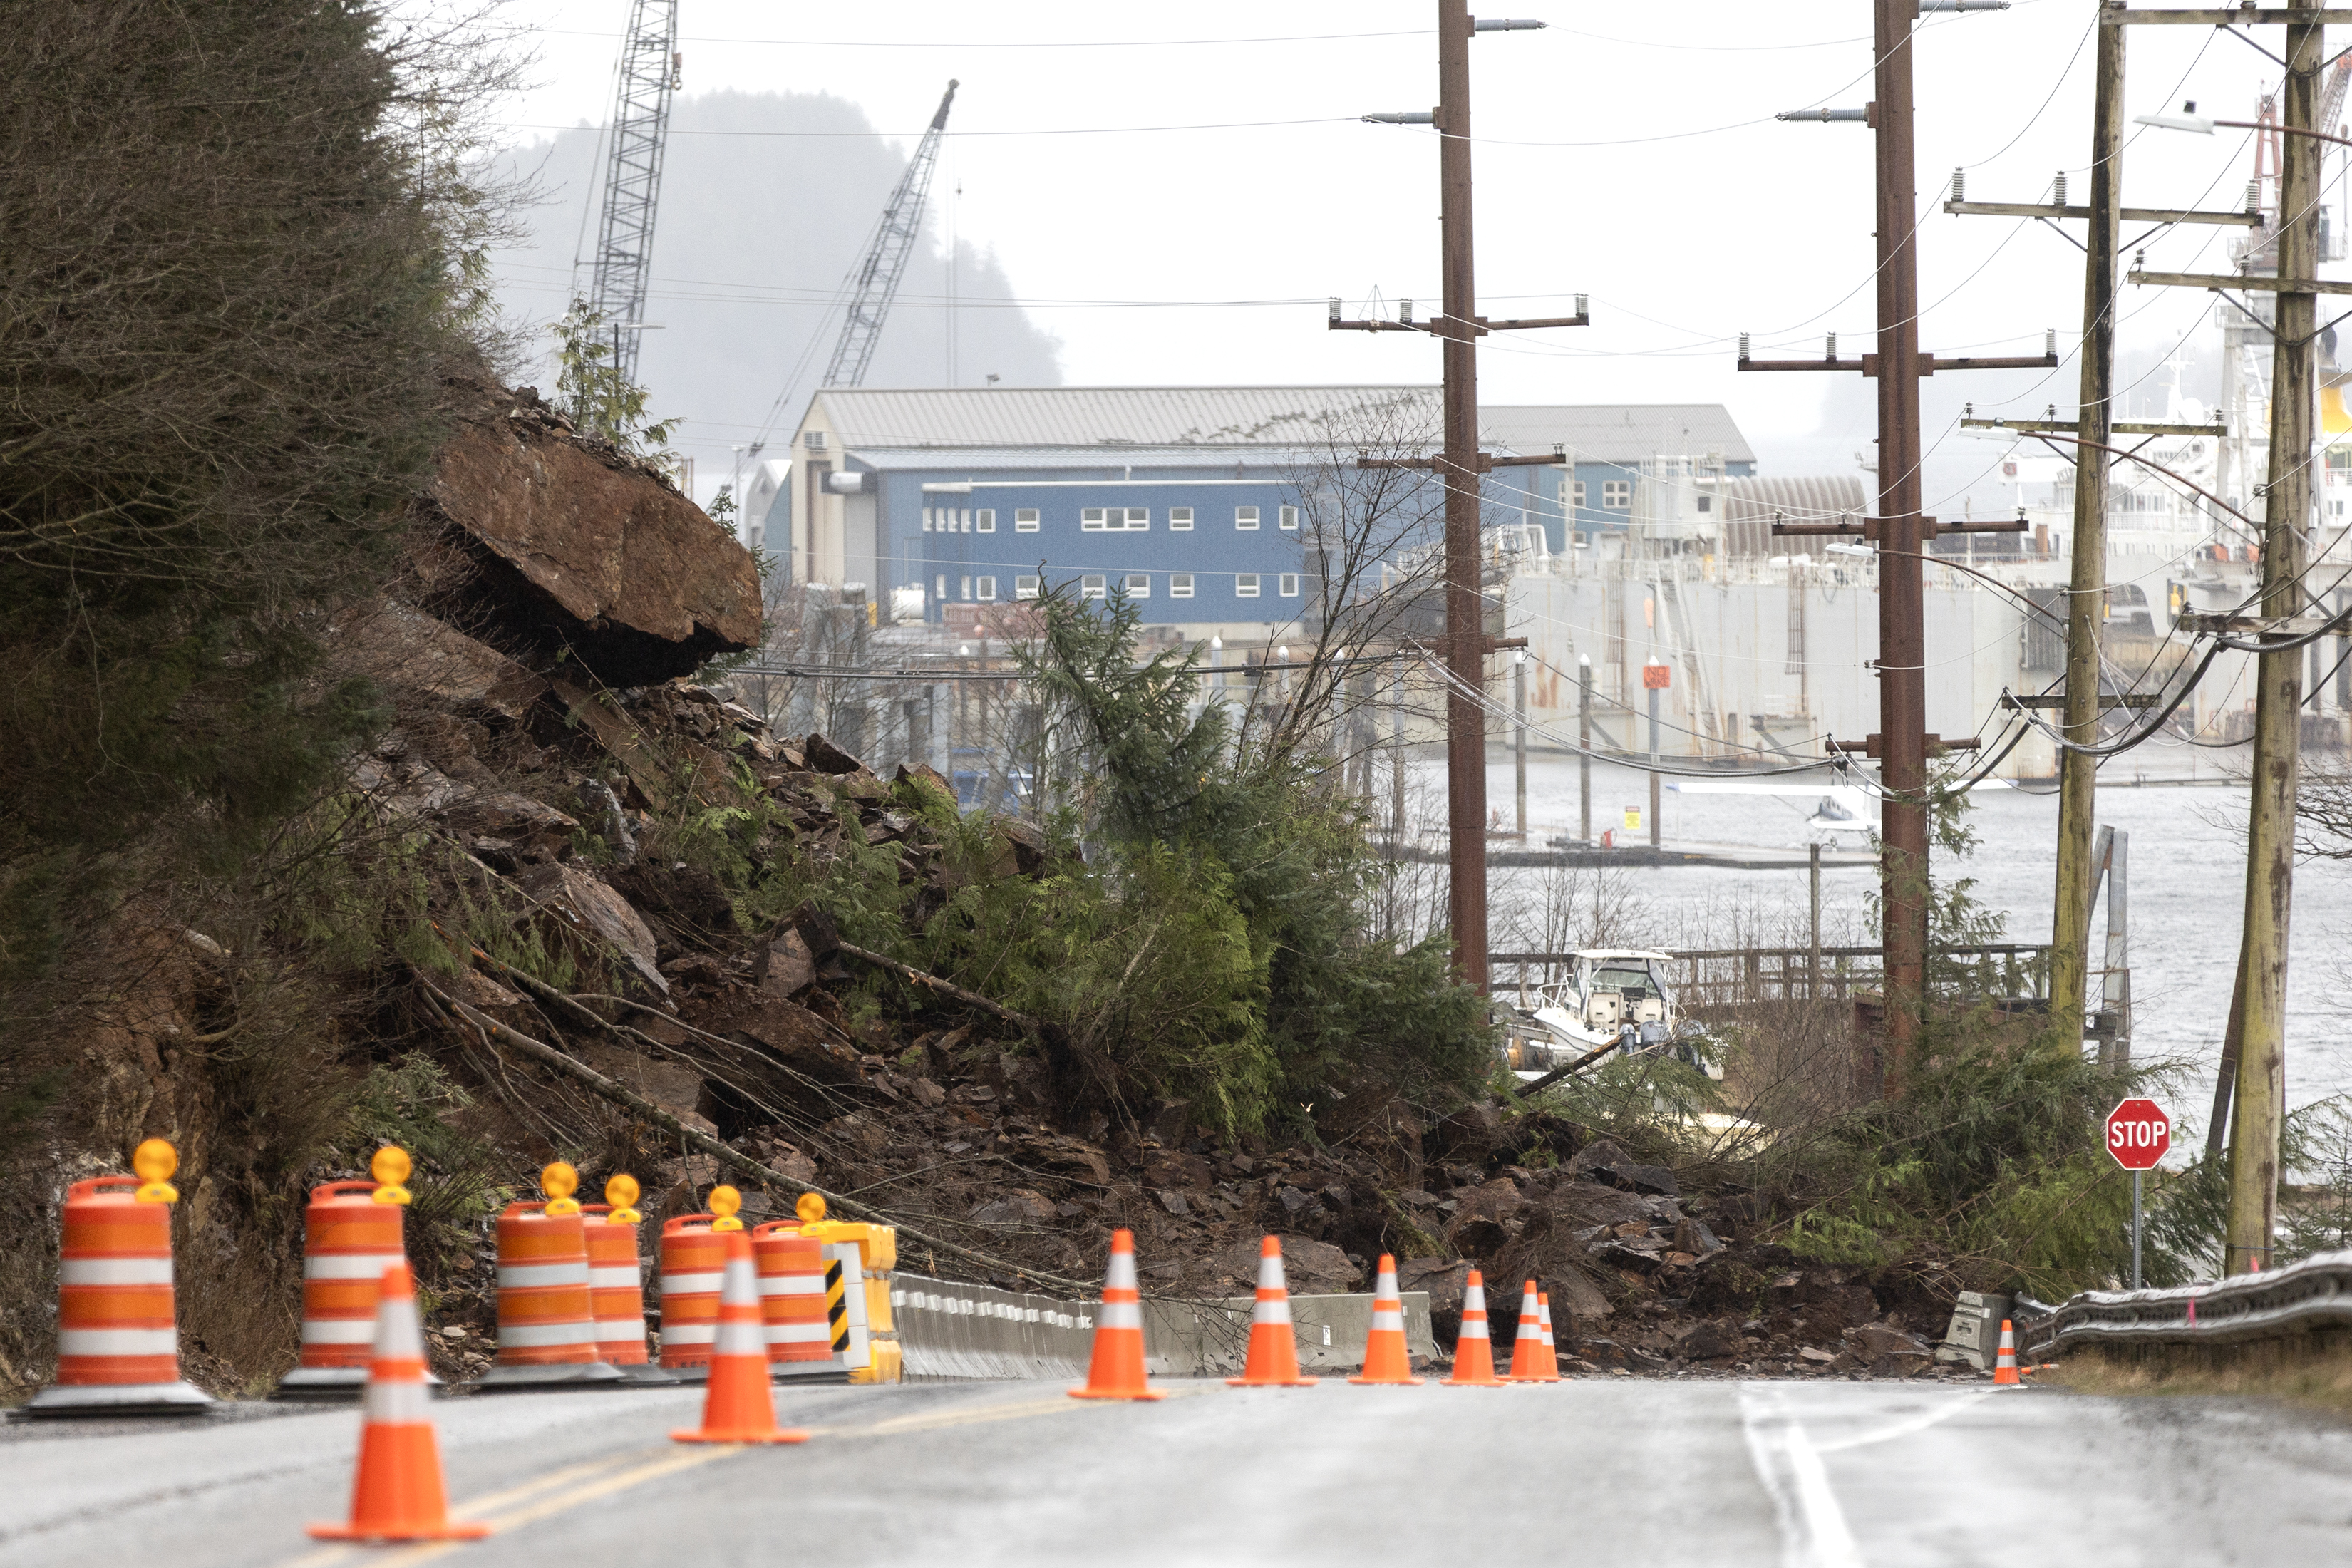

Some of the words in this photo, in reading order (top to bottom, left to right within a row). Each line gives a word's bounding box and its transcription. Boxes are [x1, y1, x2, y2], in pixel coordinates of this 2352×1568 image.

[1647, 666, 1666, 677] NO
[1644, 676, 1669, 688] WAKE
[2111, 1120, 2166, 1147] STOP
